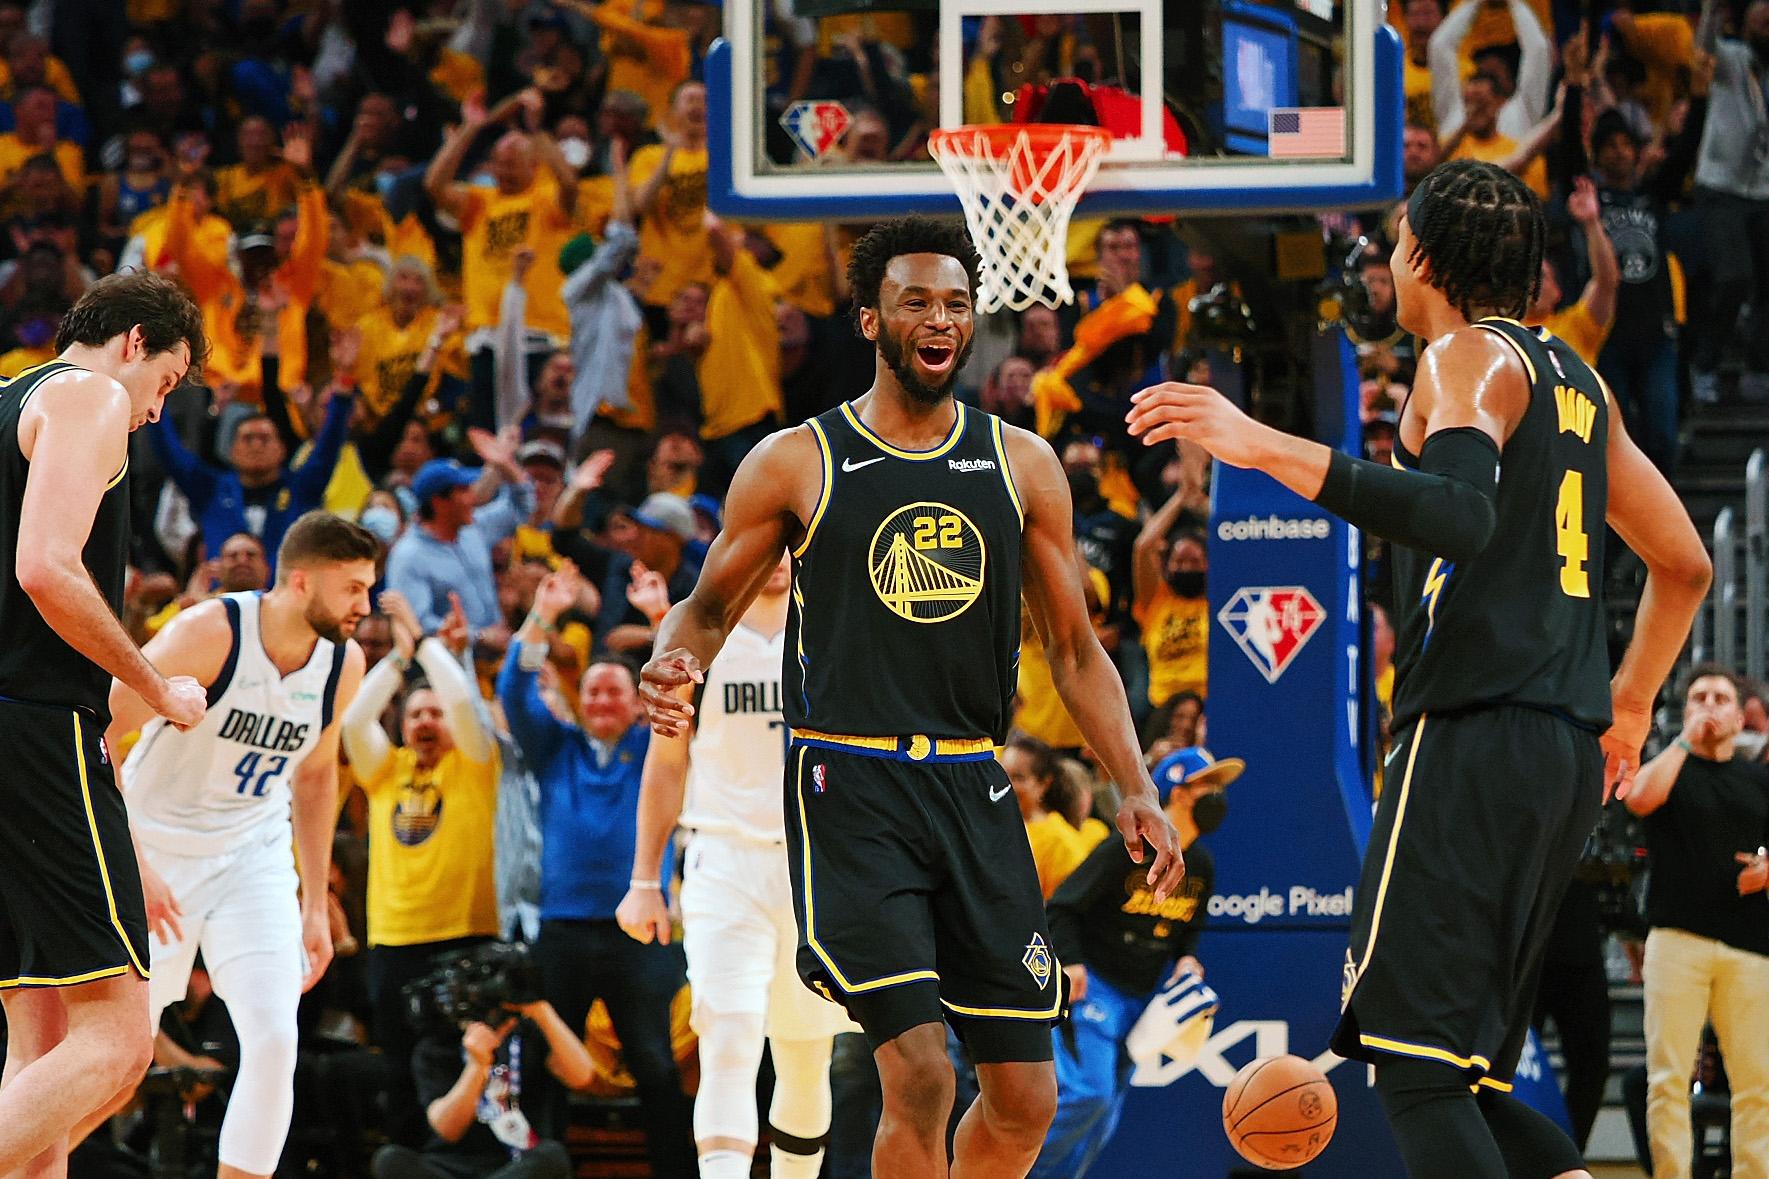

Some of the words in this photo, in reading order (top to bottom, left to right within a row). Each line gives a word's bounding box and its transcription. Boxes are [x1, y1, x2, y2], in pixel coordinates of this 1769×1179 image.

[948, 458, 996, 472] Rakuten
[913, 515, 963, 550] 22
[1217, 514, 1330, 541] coinbase
[1555, 469, 1591, 598] 4
[724, 681, 783, 714] DALL
[218, 707, 310, 752] DALLAS
[233, 751, 289, 797] 42
[1206, 886, 1284, 924] oogle
[1288, 885, 1354, 916] Pixel
